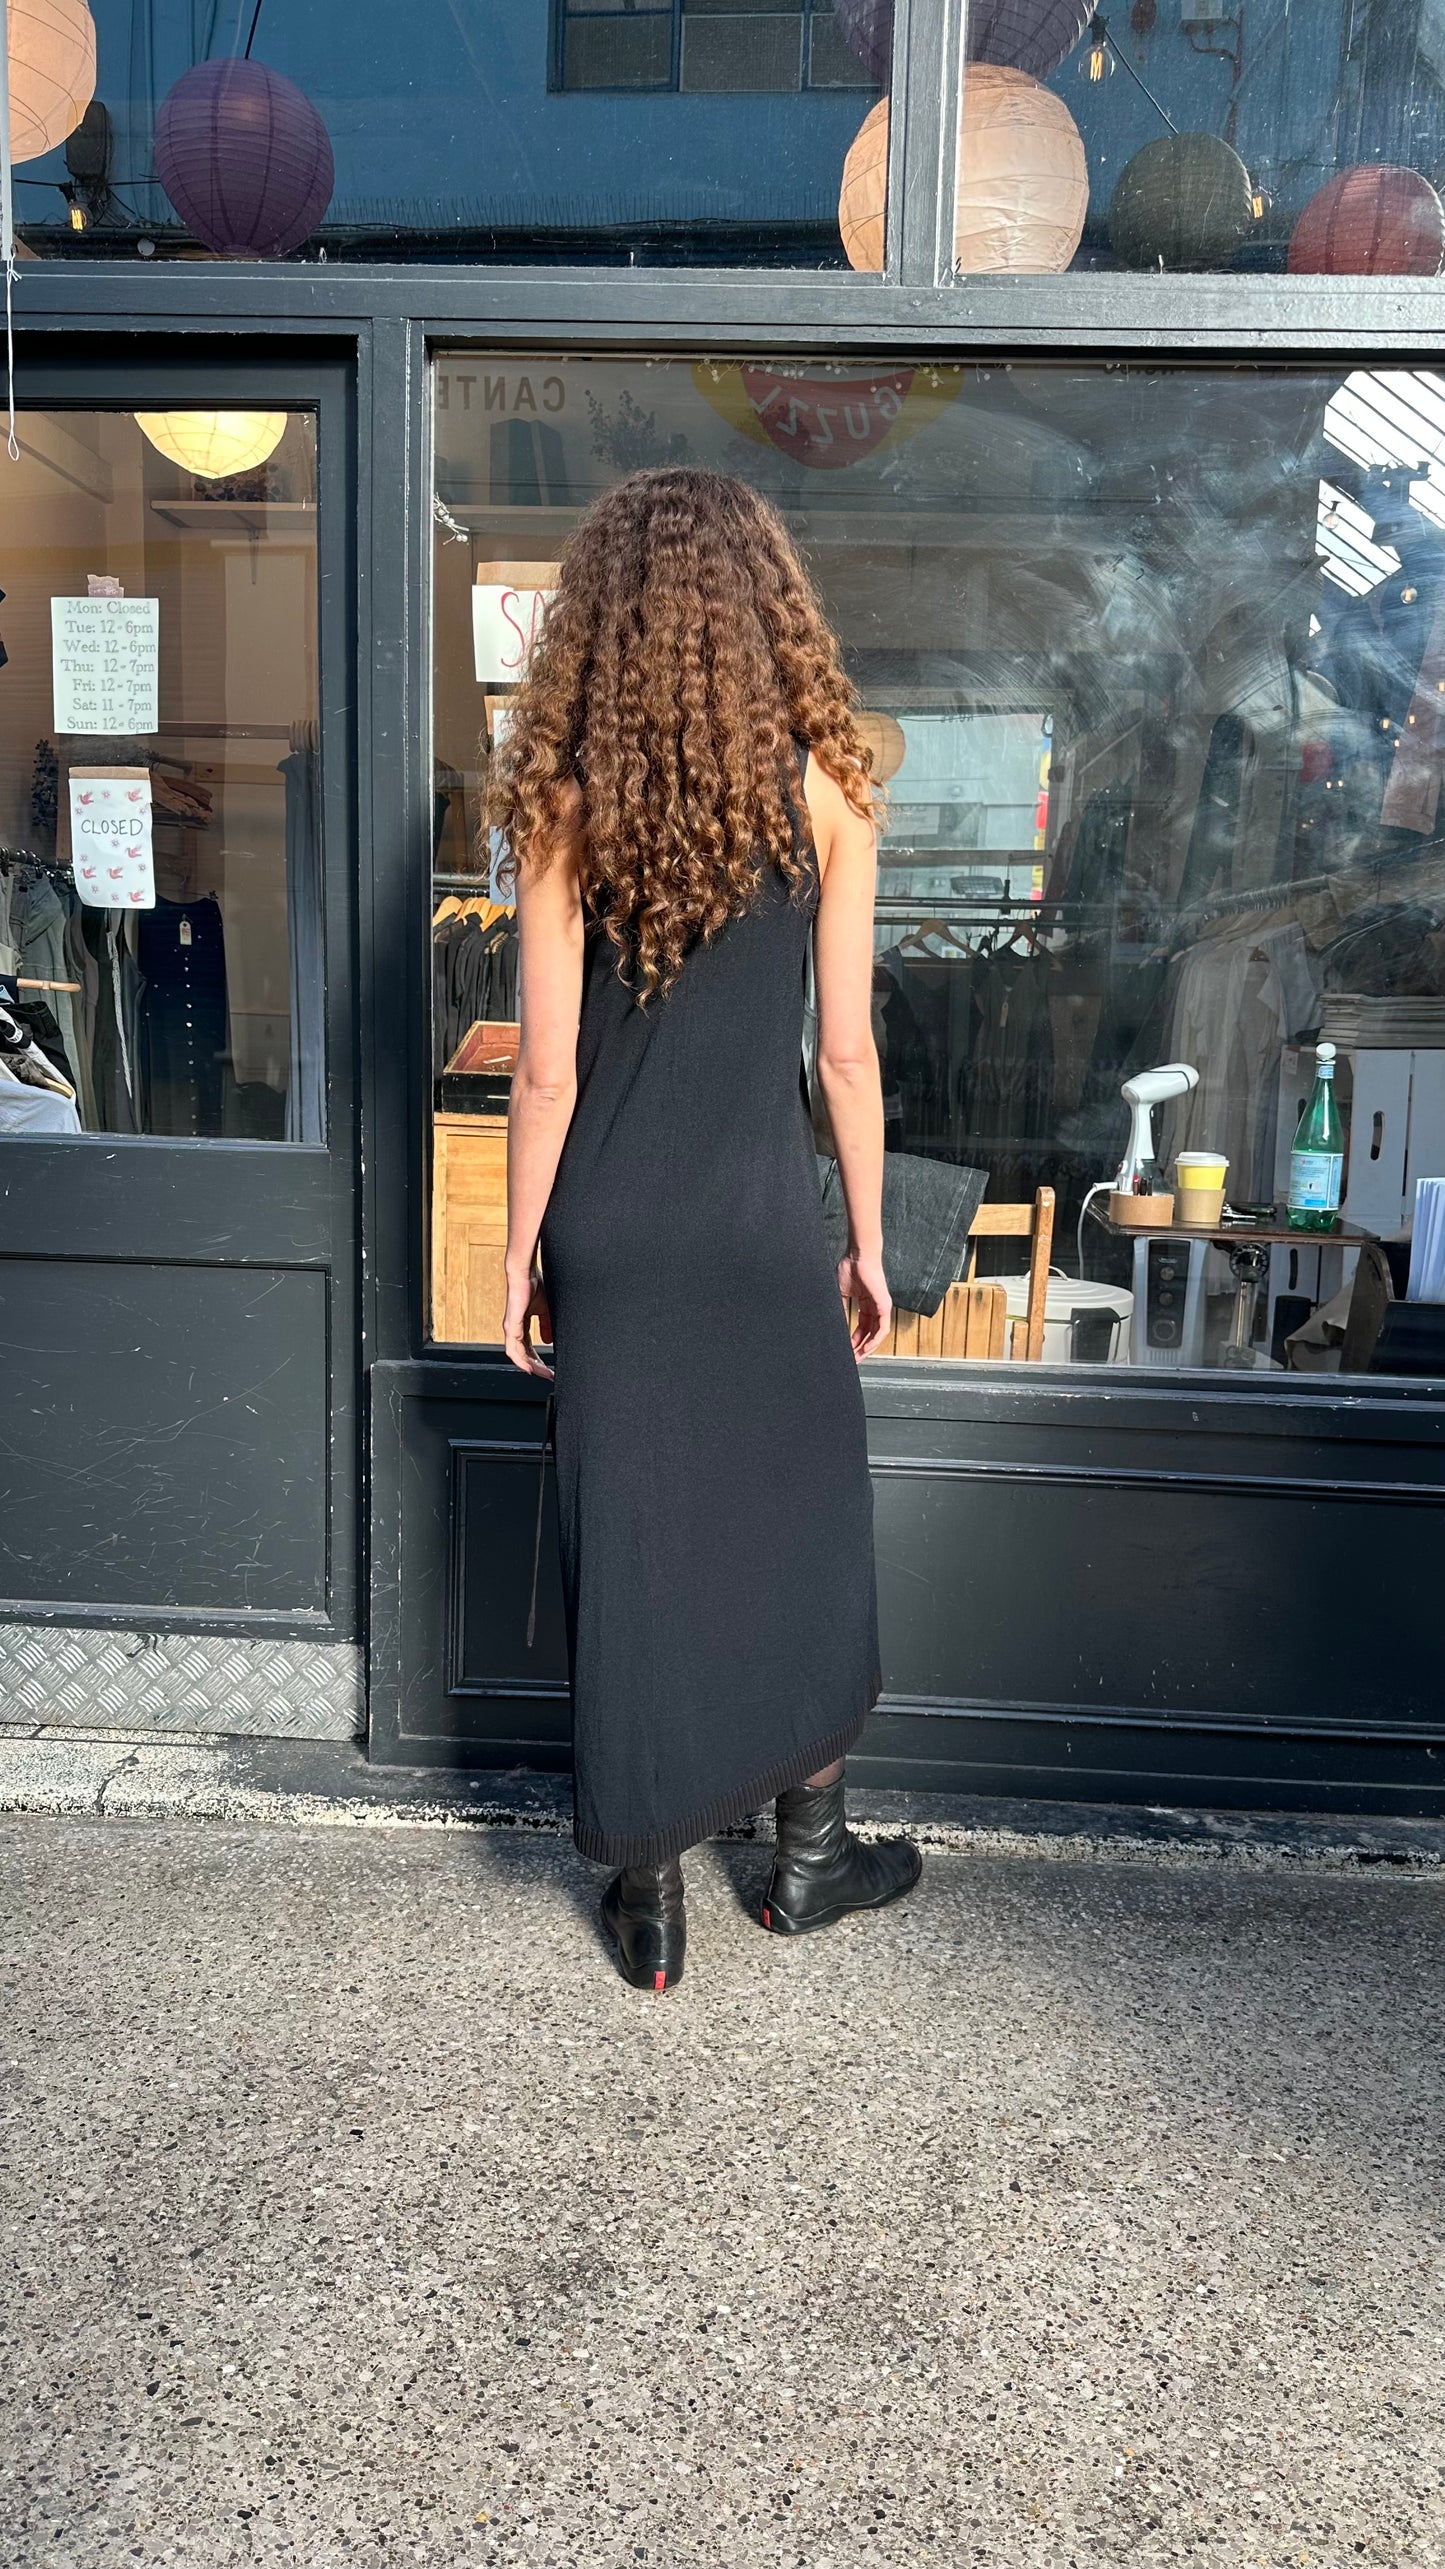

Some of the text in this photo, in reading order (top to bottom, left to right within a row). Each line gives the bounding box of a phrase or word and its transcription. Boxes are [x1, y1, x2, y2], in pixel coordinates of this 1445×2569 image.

[67, 601, 150, 614] Mon: Closed
[65, 620, 96, 633] Tue:
[63, 639, 101, 653] Wed:
[61, 659, 94, 672] Thu:
[72, 678, 96, 692] Fri:
[72, 698, 97, 711] Sat:
[66, 716, 98, 730] Sun:
[81, 818, 143, 836] CLOSED
